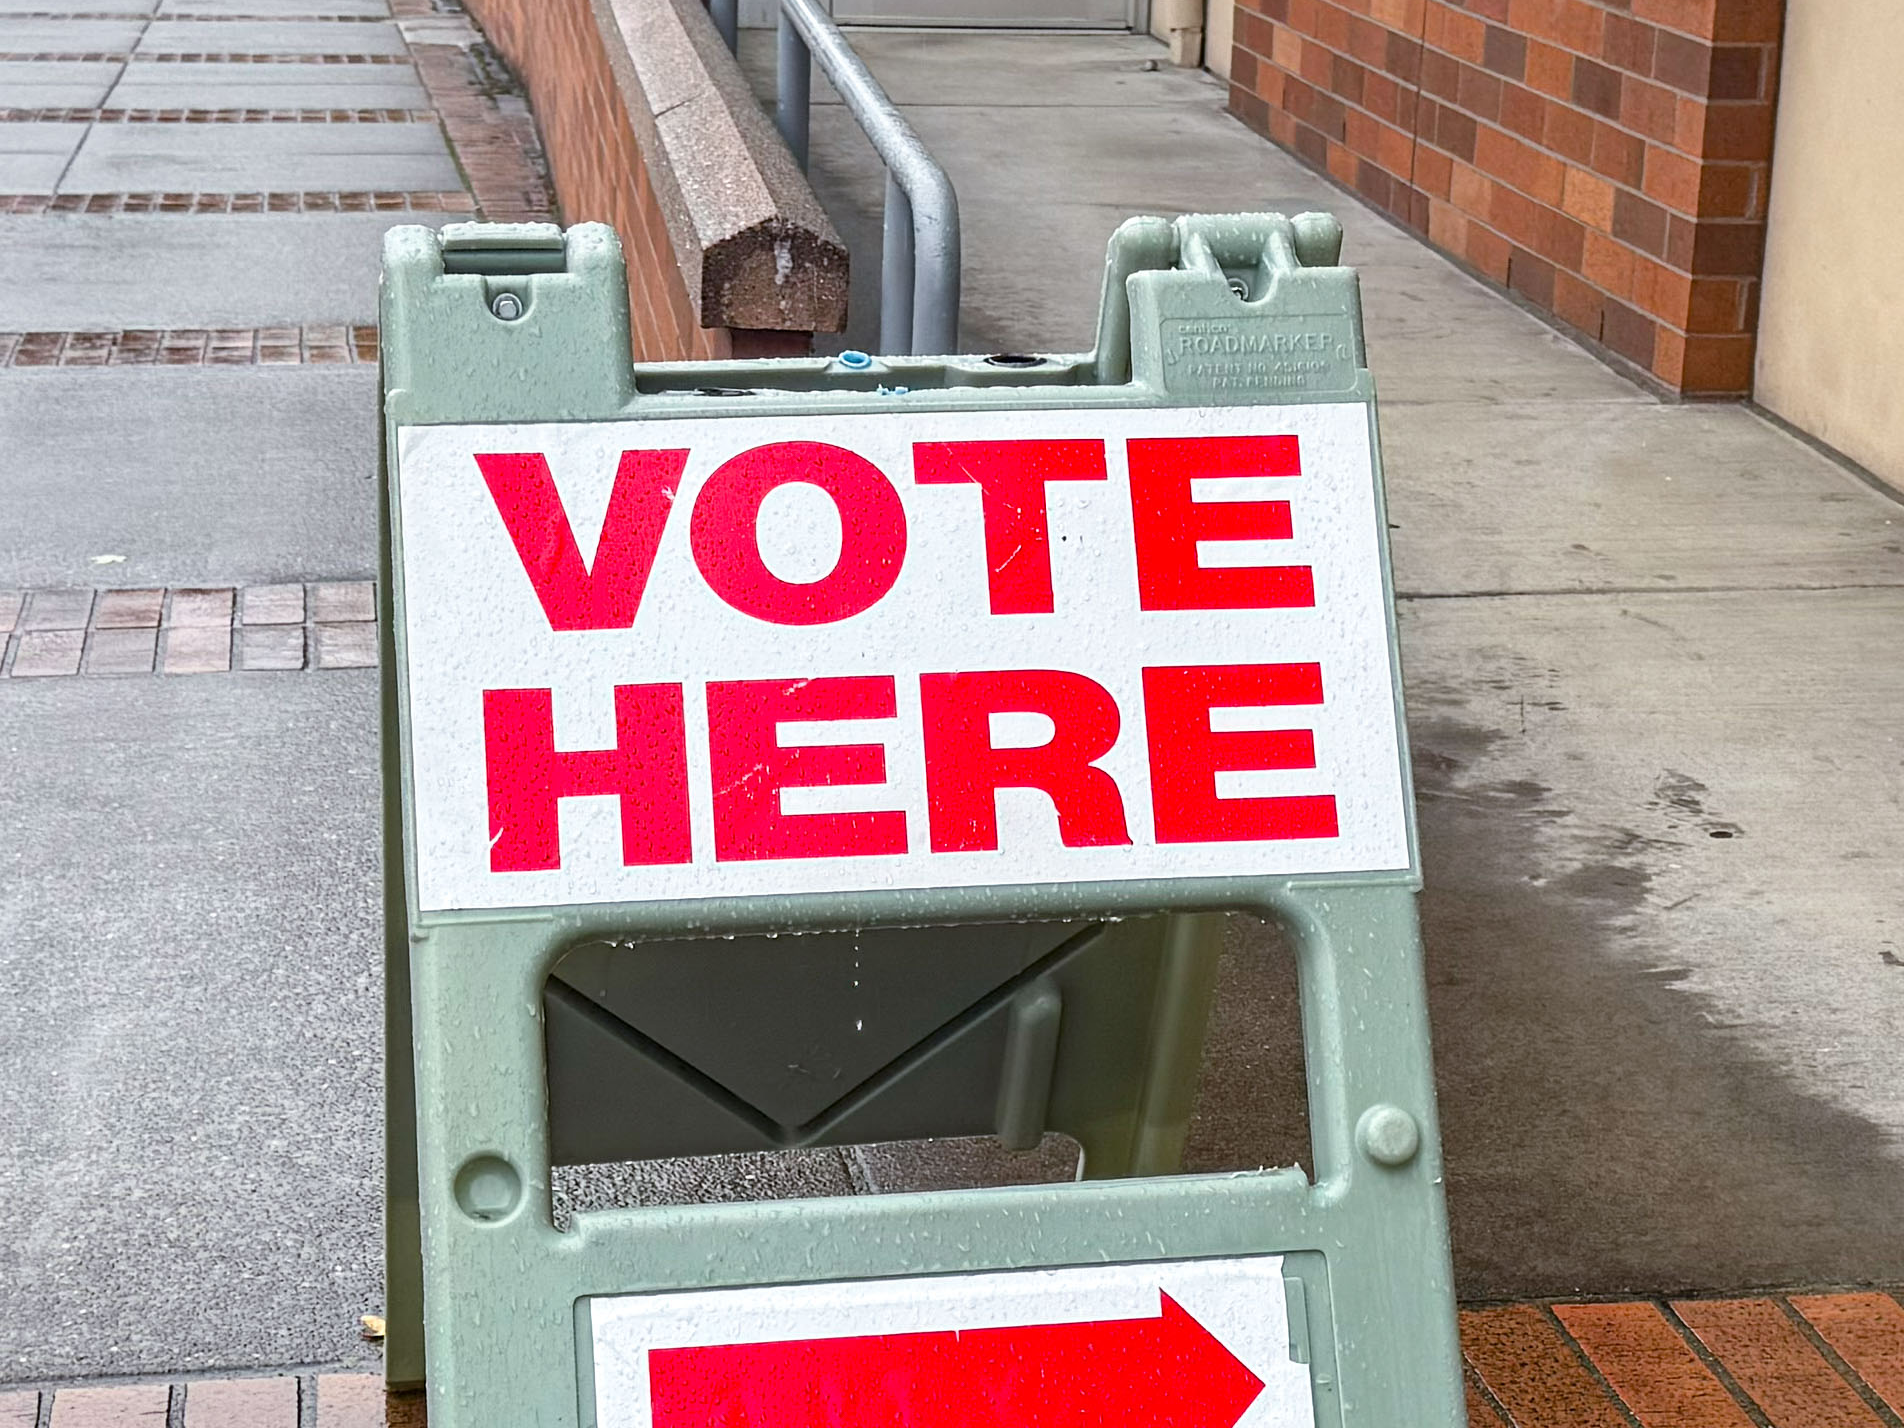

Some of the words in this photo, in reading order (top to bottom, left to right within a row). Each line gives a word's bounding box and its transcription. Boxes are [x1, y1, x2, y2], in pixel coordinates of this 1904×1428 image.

[1179, 332, 1333, 356] ROADMARKER
[473, 434, 1316, 632] VOTE
[482, 662, 1341, 873] HERE
